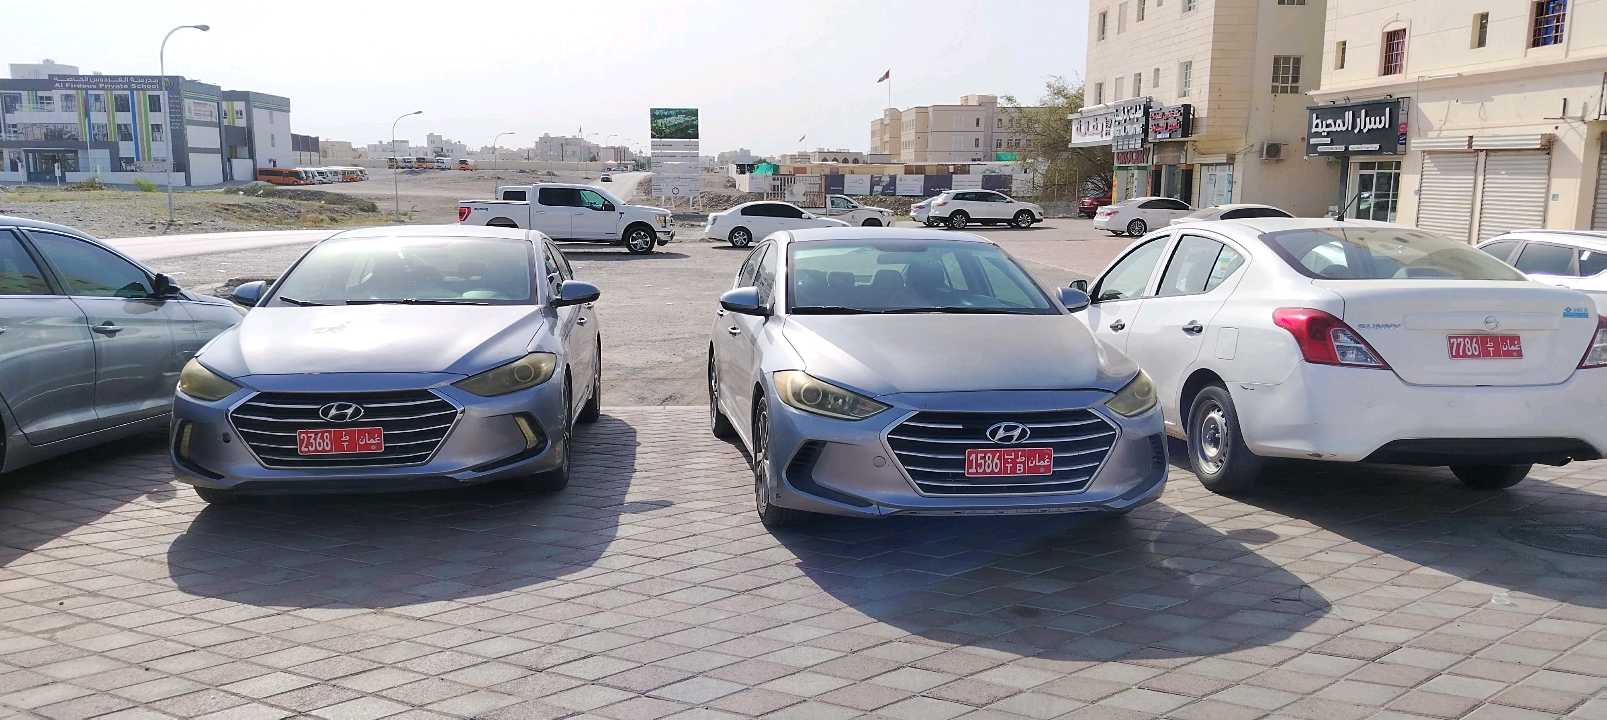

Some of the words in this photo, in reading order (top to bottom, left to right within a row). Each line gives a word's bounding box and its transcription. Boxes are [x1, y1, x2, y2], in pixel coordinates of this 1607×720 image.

[1311, 110, 1353, 136] المحيط
[1354, 107, 1390, 134] اسرار
[1450, 337, 1479, 356] 7786
[300, 432, 331, 452] 2368
[341, 442, 350, 451] T
[968, 452, 1001, 473] 1586
